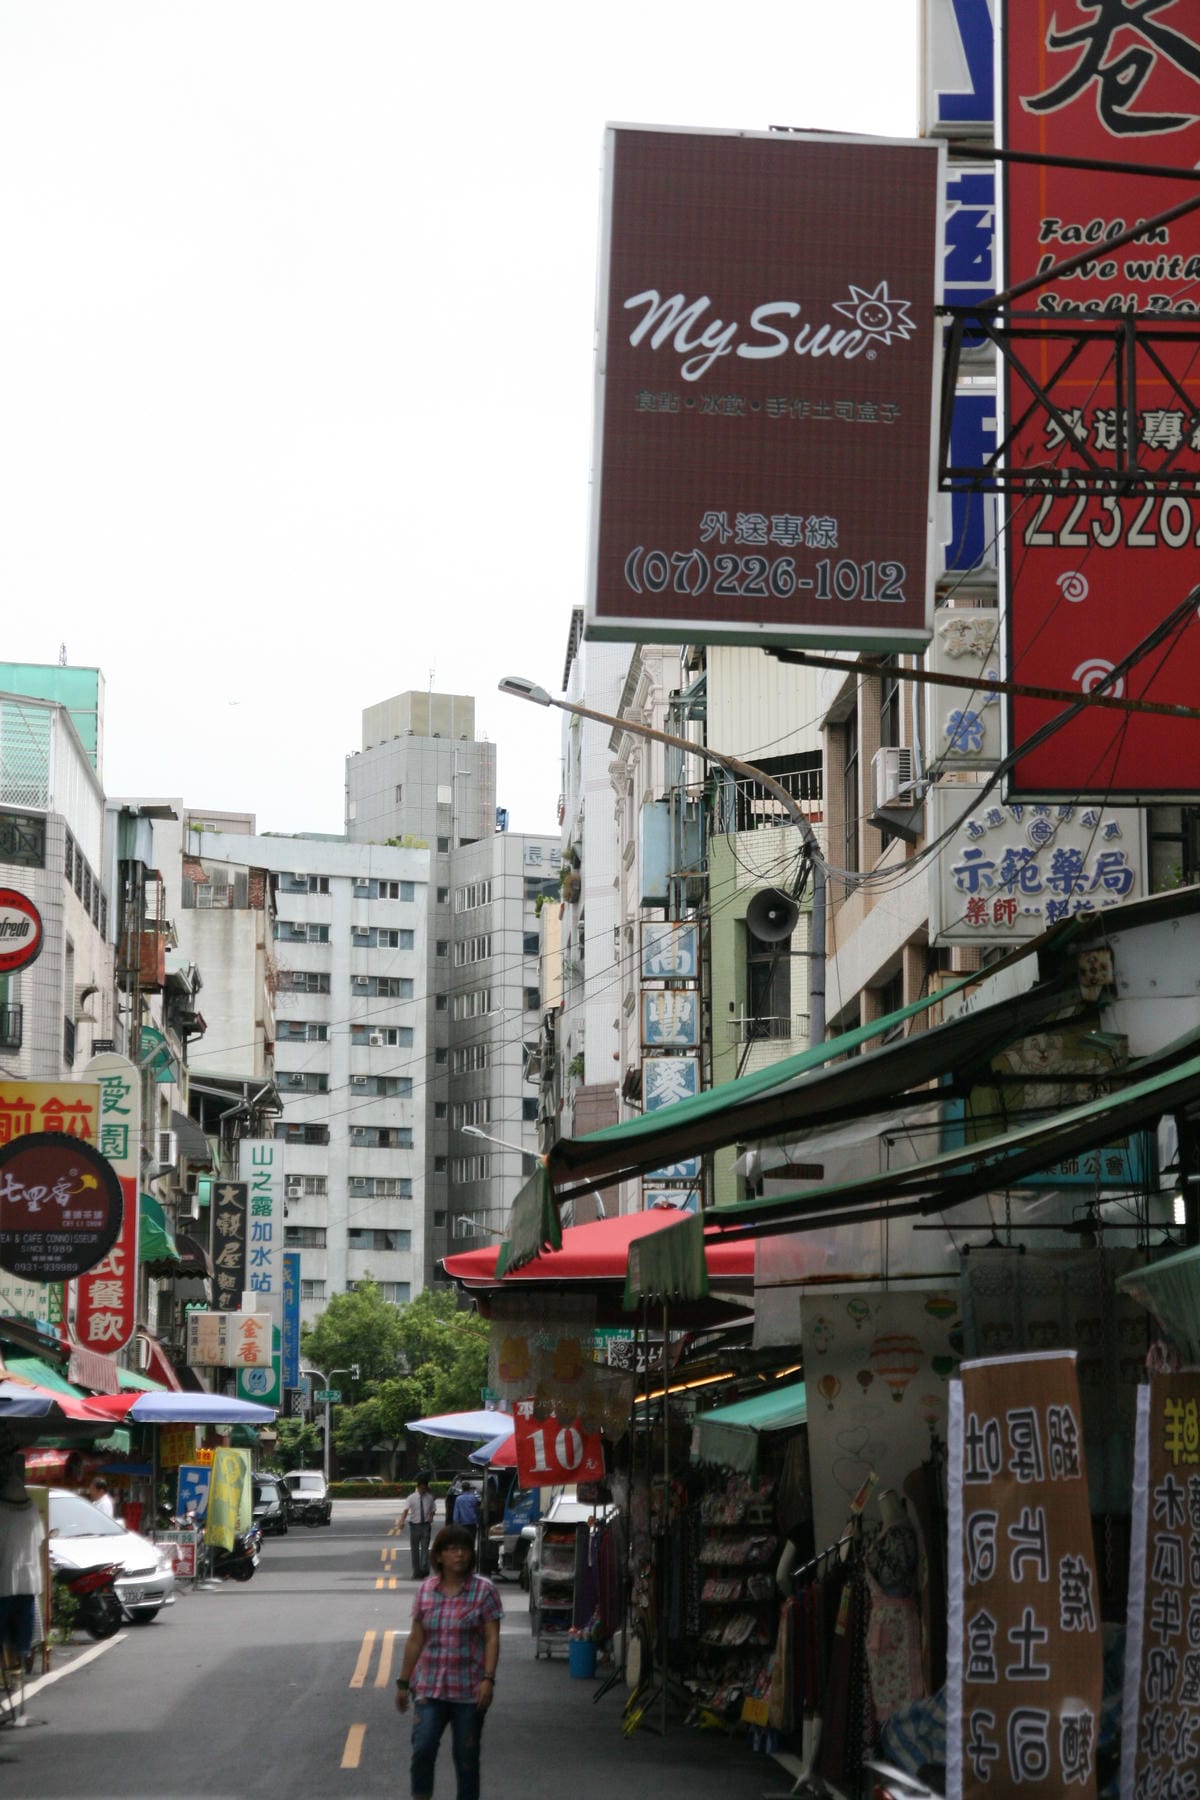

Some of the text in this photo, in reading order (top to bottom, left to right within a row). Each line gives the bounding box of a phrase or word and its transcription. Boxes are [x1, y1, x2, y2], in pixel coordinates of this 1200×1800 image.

[1038, 217, 1126, 245] Fall
[1037, 254, 1200, 281] Love with
[623, 289, 866, 382] My Sun
[1046, 408, 1200, 450] 外送專
[699, 511, 838, 549] 外送專線
[1025, 470, 1200, 548] 22326
[953, 846, 1134, 895] 示範藥局
[100, 1077, 131, 1160] 愛園
[250, 1145, 273, 1293] 山之露加水站
[526, 1427, 584, 1472] 10
